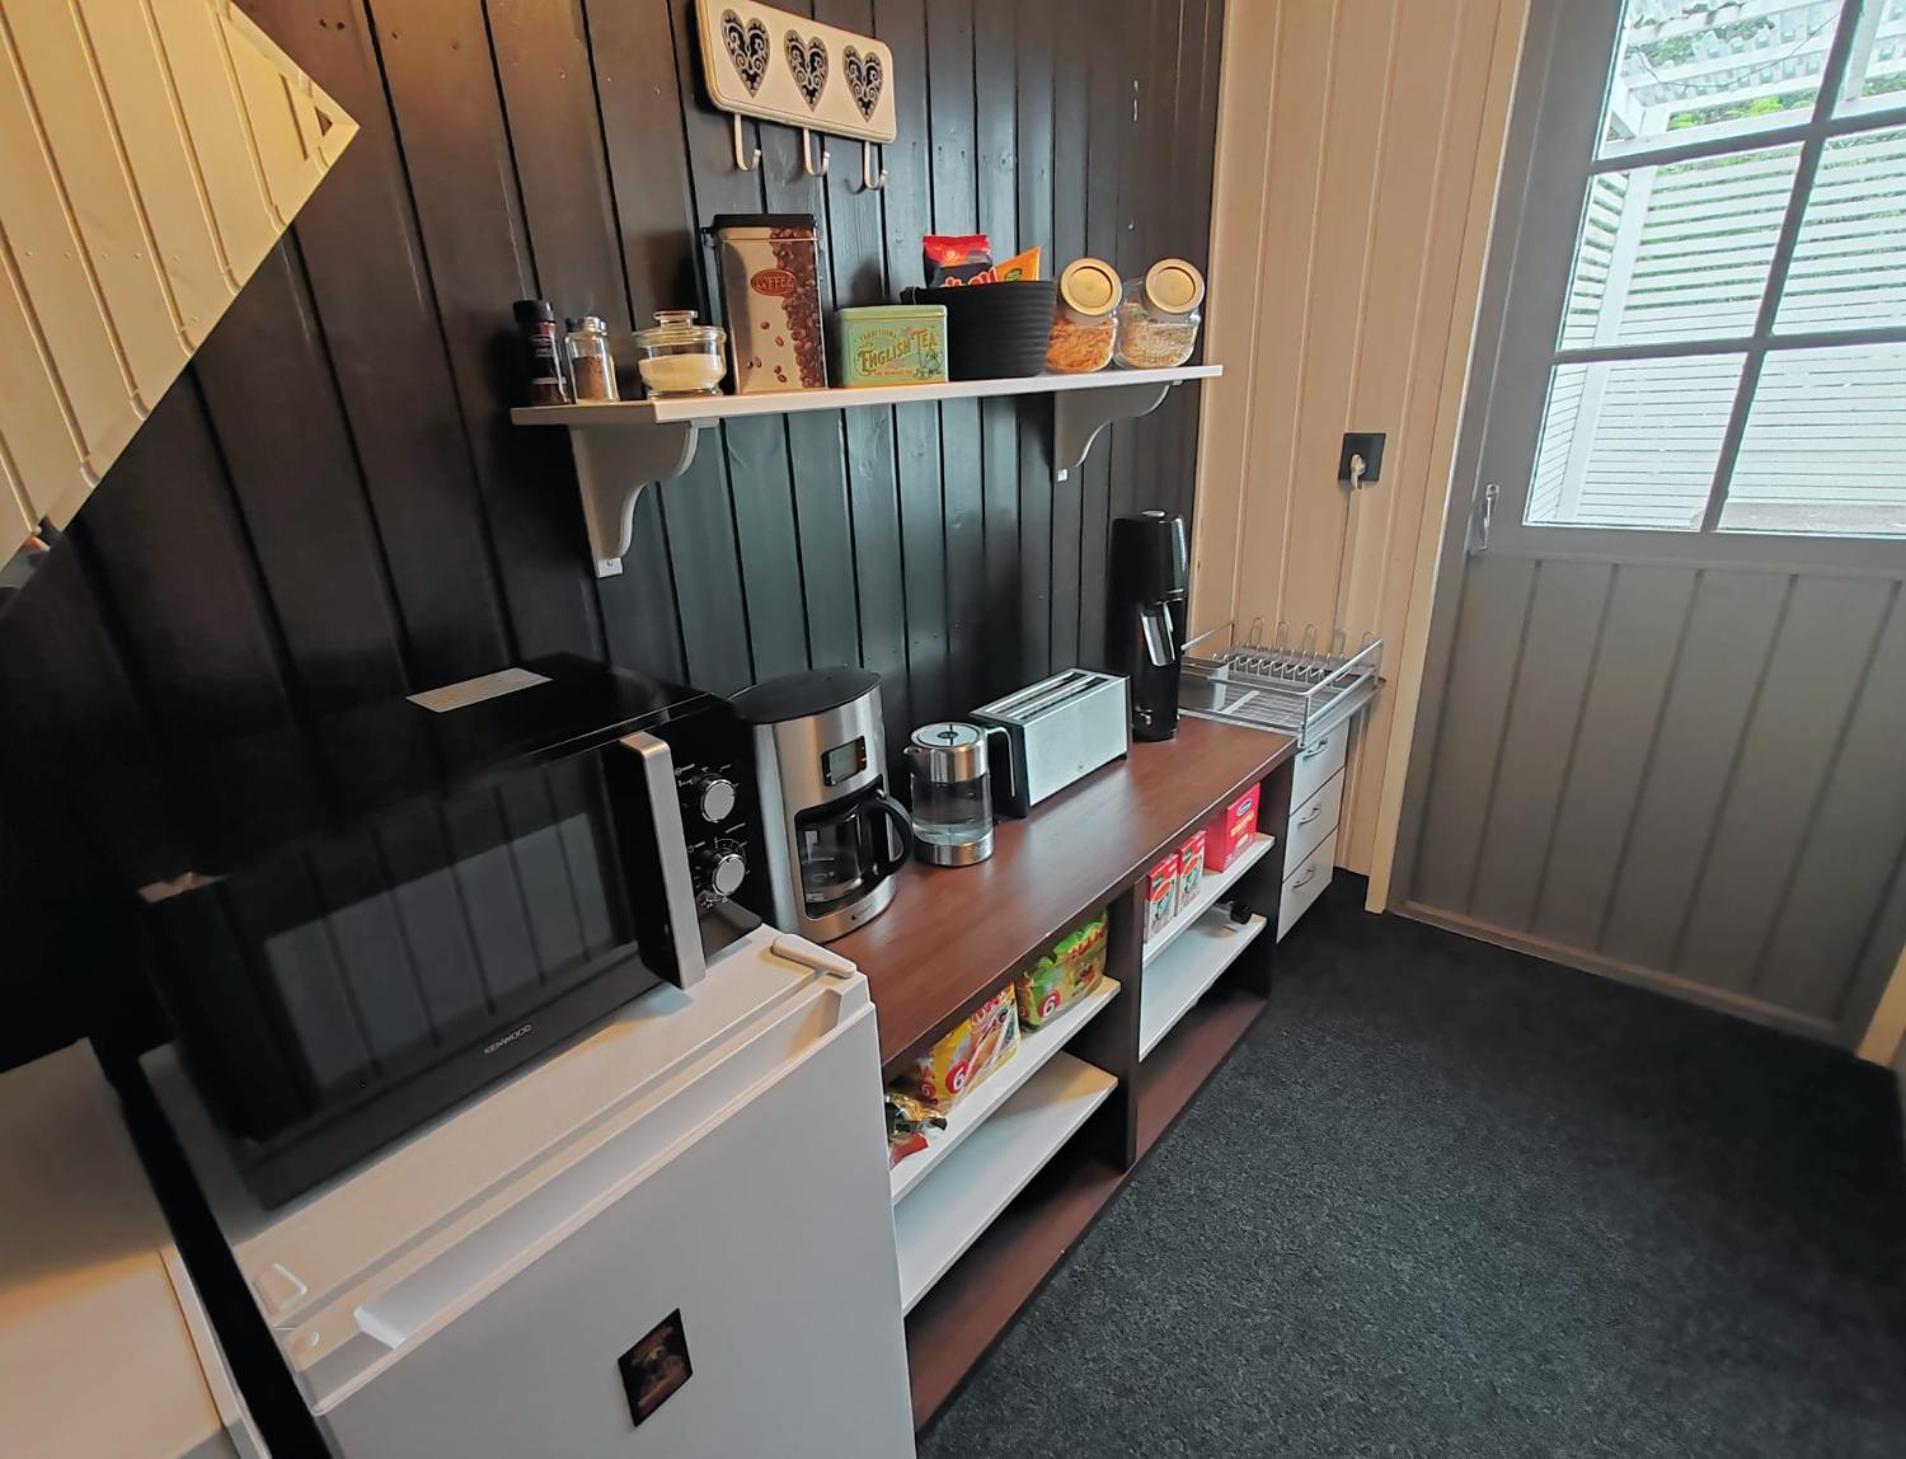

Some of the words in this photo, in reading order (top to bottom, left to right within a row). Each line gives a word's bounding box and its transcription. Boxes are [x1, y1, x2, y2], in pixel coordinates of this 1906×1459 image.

[857, 338, 911, 373] ENGLISH
[911, 327, 939, 352] TEA
[1043, 994, 1056, 1018] 6
[484, 1024, 532, 1055] KENWOOD
[953, 1065, 967, 1090] 6
